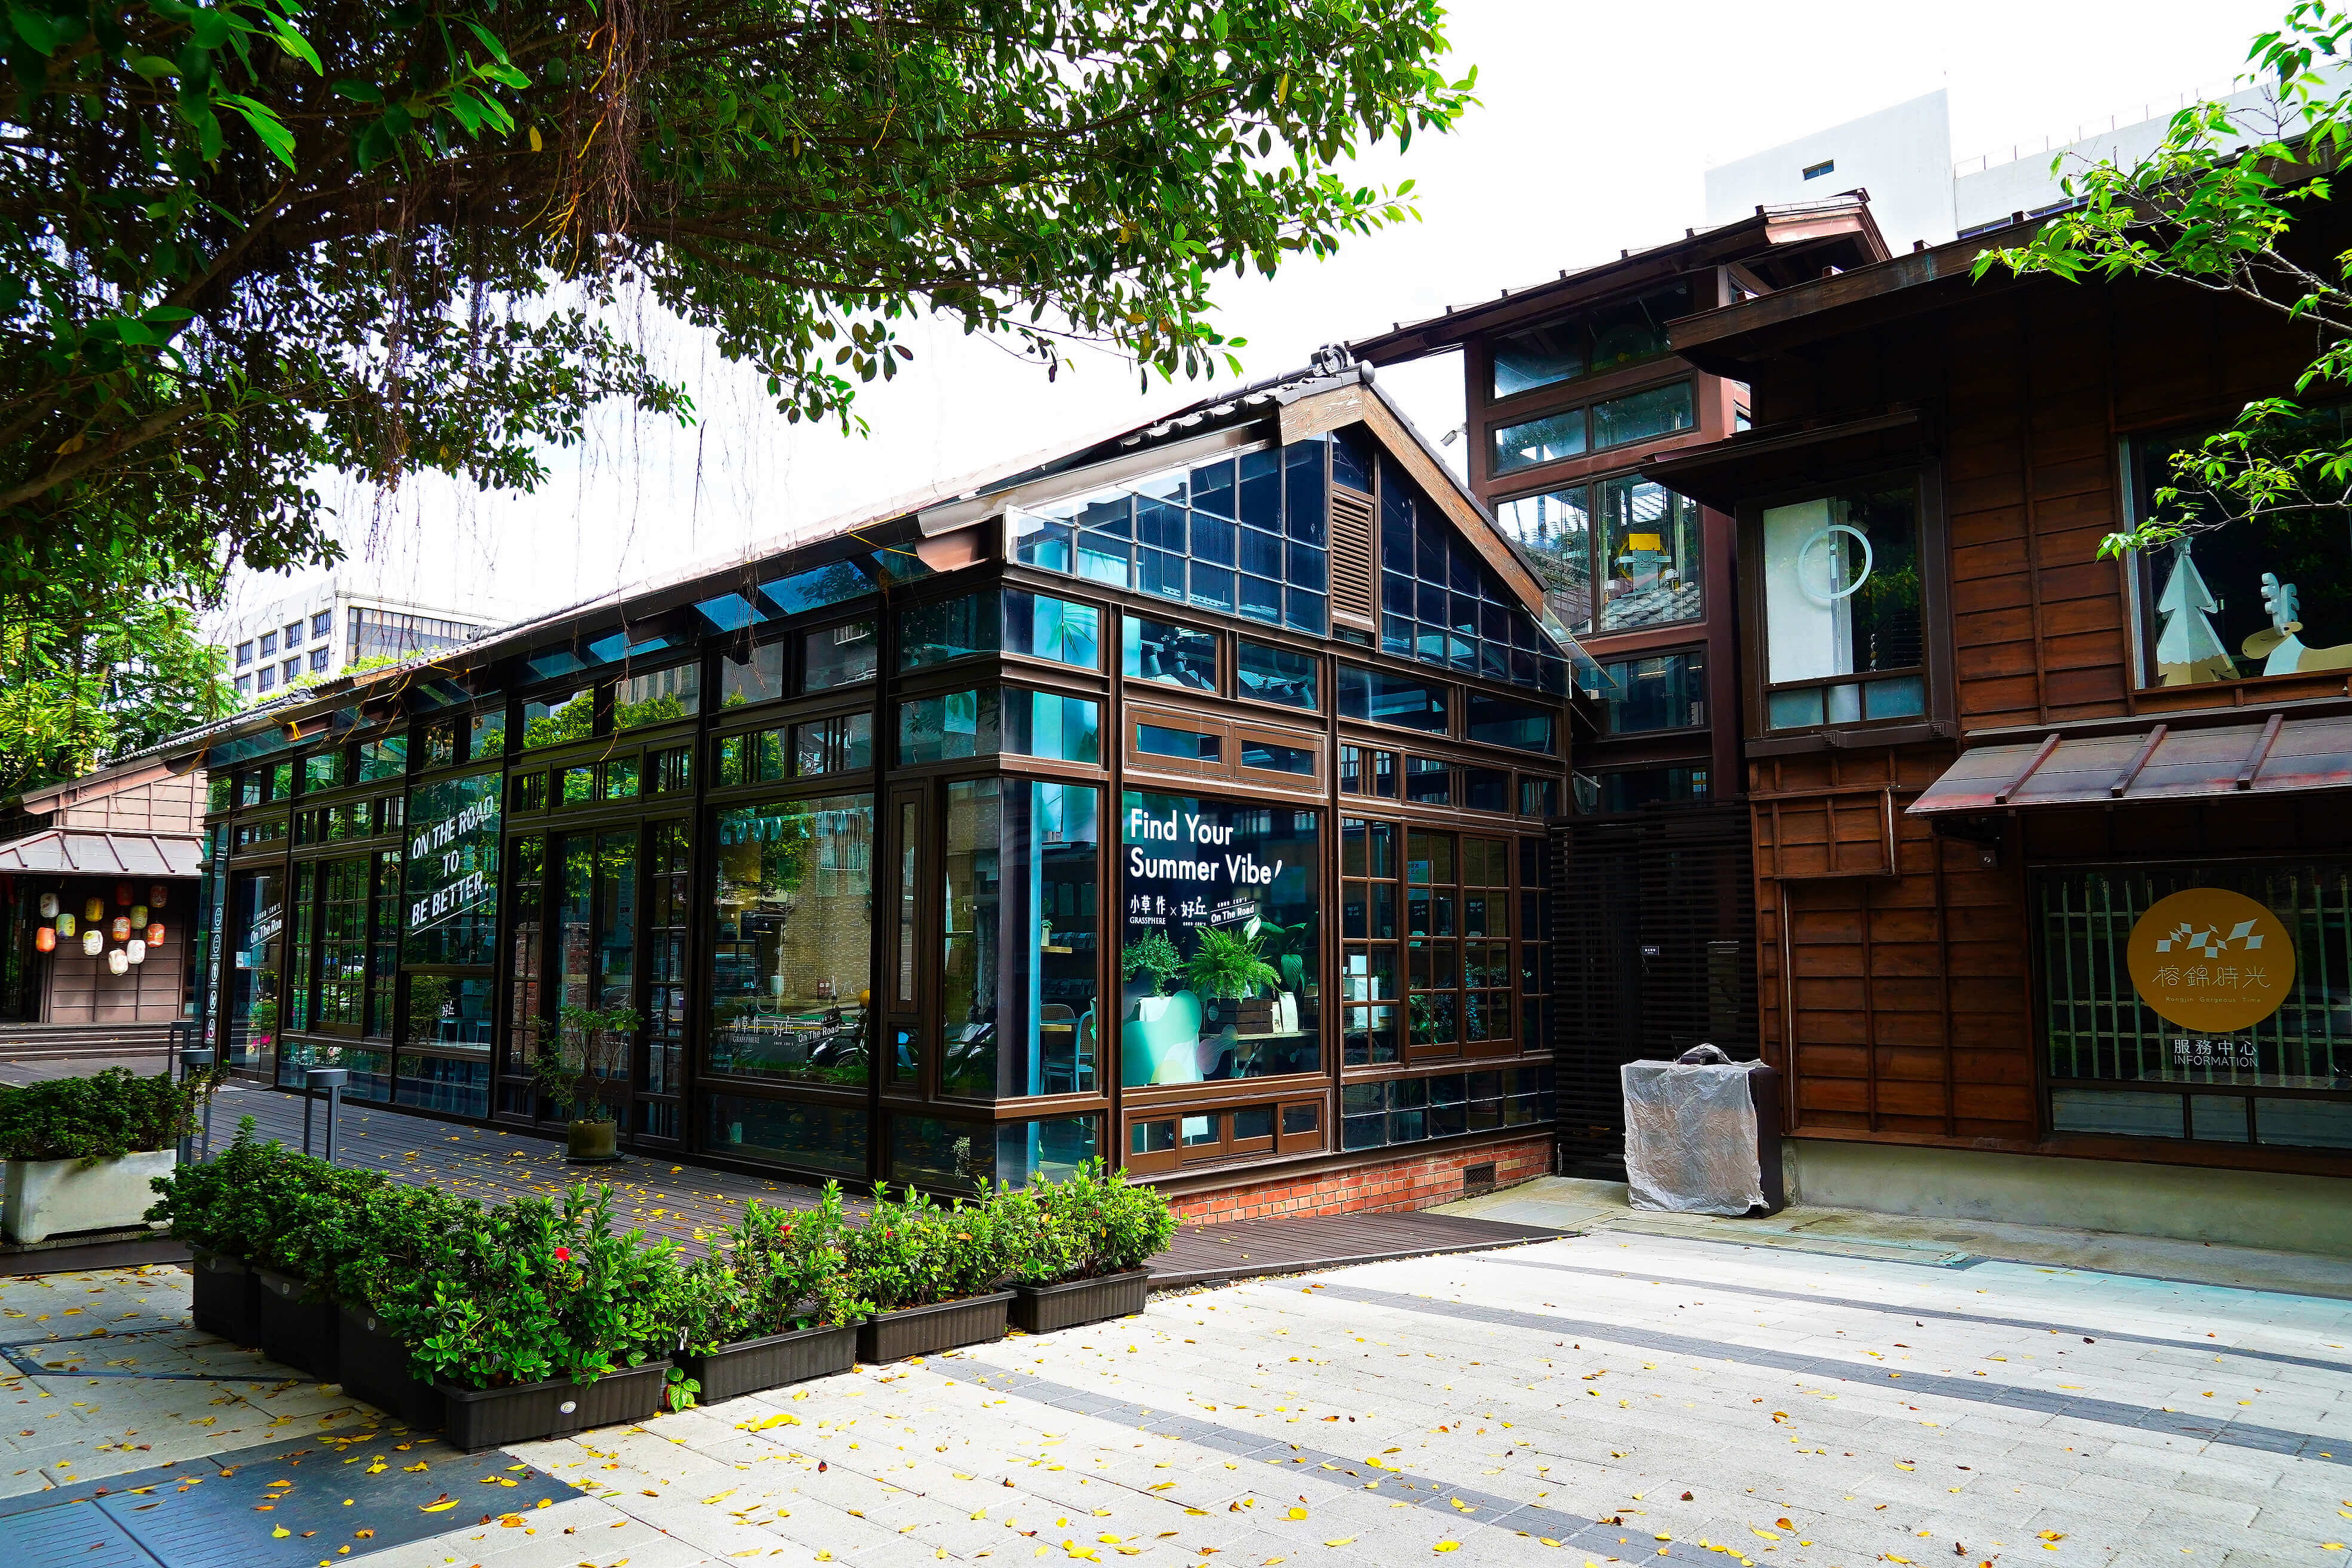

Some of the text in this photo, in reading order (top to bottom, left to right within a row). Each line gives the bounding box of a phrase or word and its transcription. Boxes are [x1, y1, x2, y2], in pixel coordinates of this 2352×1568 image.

[413, 795, 494, 859] ON THE ROAD
[1131, 808, 1234, 846] Find Your
[443, 849, 459, 877] TO
[1130, 847, 1219, 881] Summer
[412, 898, 428, 927] BE
[1181, 896, 1208, 918] 好丘
[1211, 904, 1255, 923] On The Road
[251, 931, 259, 943] On
[260, 924, 270, 938] The
[2152, 964, 2271, 989] 榕錦時光
[442, 1000, 454, 1017] 好丘
[773, 1016, 795, 1037] 好丘
[798, 1024, 839, 1043] On The Road
[2174, 1039, 2256, 1056] 服務中心
[2174, 1055, 2258, 1067] INFORMATION
